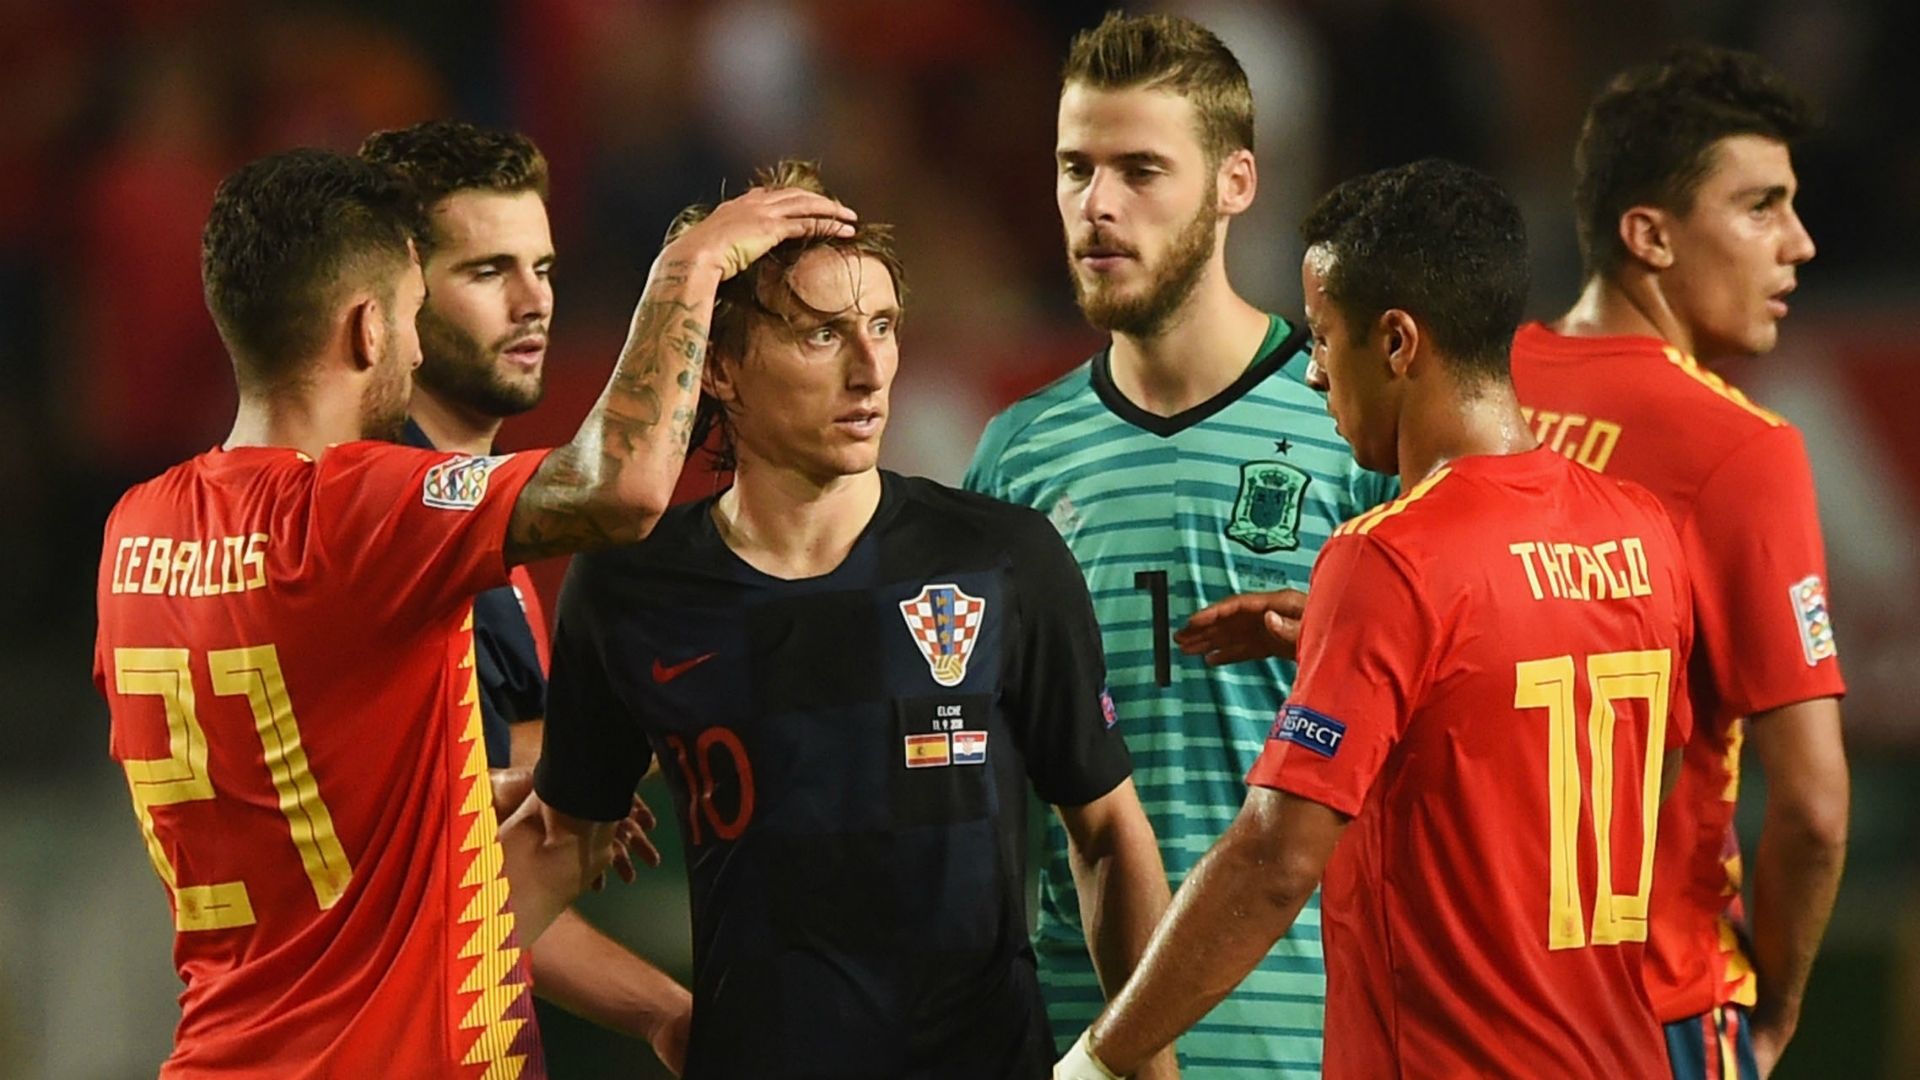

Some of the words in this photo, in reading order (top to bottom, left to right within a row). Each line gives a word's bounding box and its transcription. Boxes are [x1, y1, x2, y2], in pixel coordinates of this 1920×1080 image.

[1520, 406, 1622, 474] IGO
[111, 532, 269, 597] CEBALLOS
[1509, 537, 1652, 601] THIAGO
[1133, 570, 1171, 688] 1
[113, 644, 353, 931] 21
[666, 726, 755, 846] 10
[1515, 649, 1671, 951] 10
